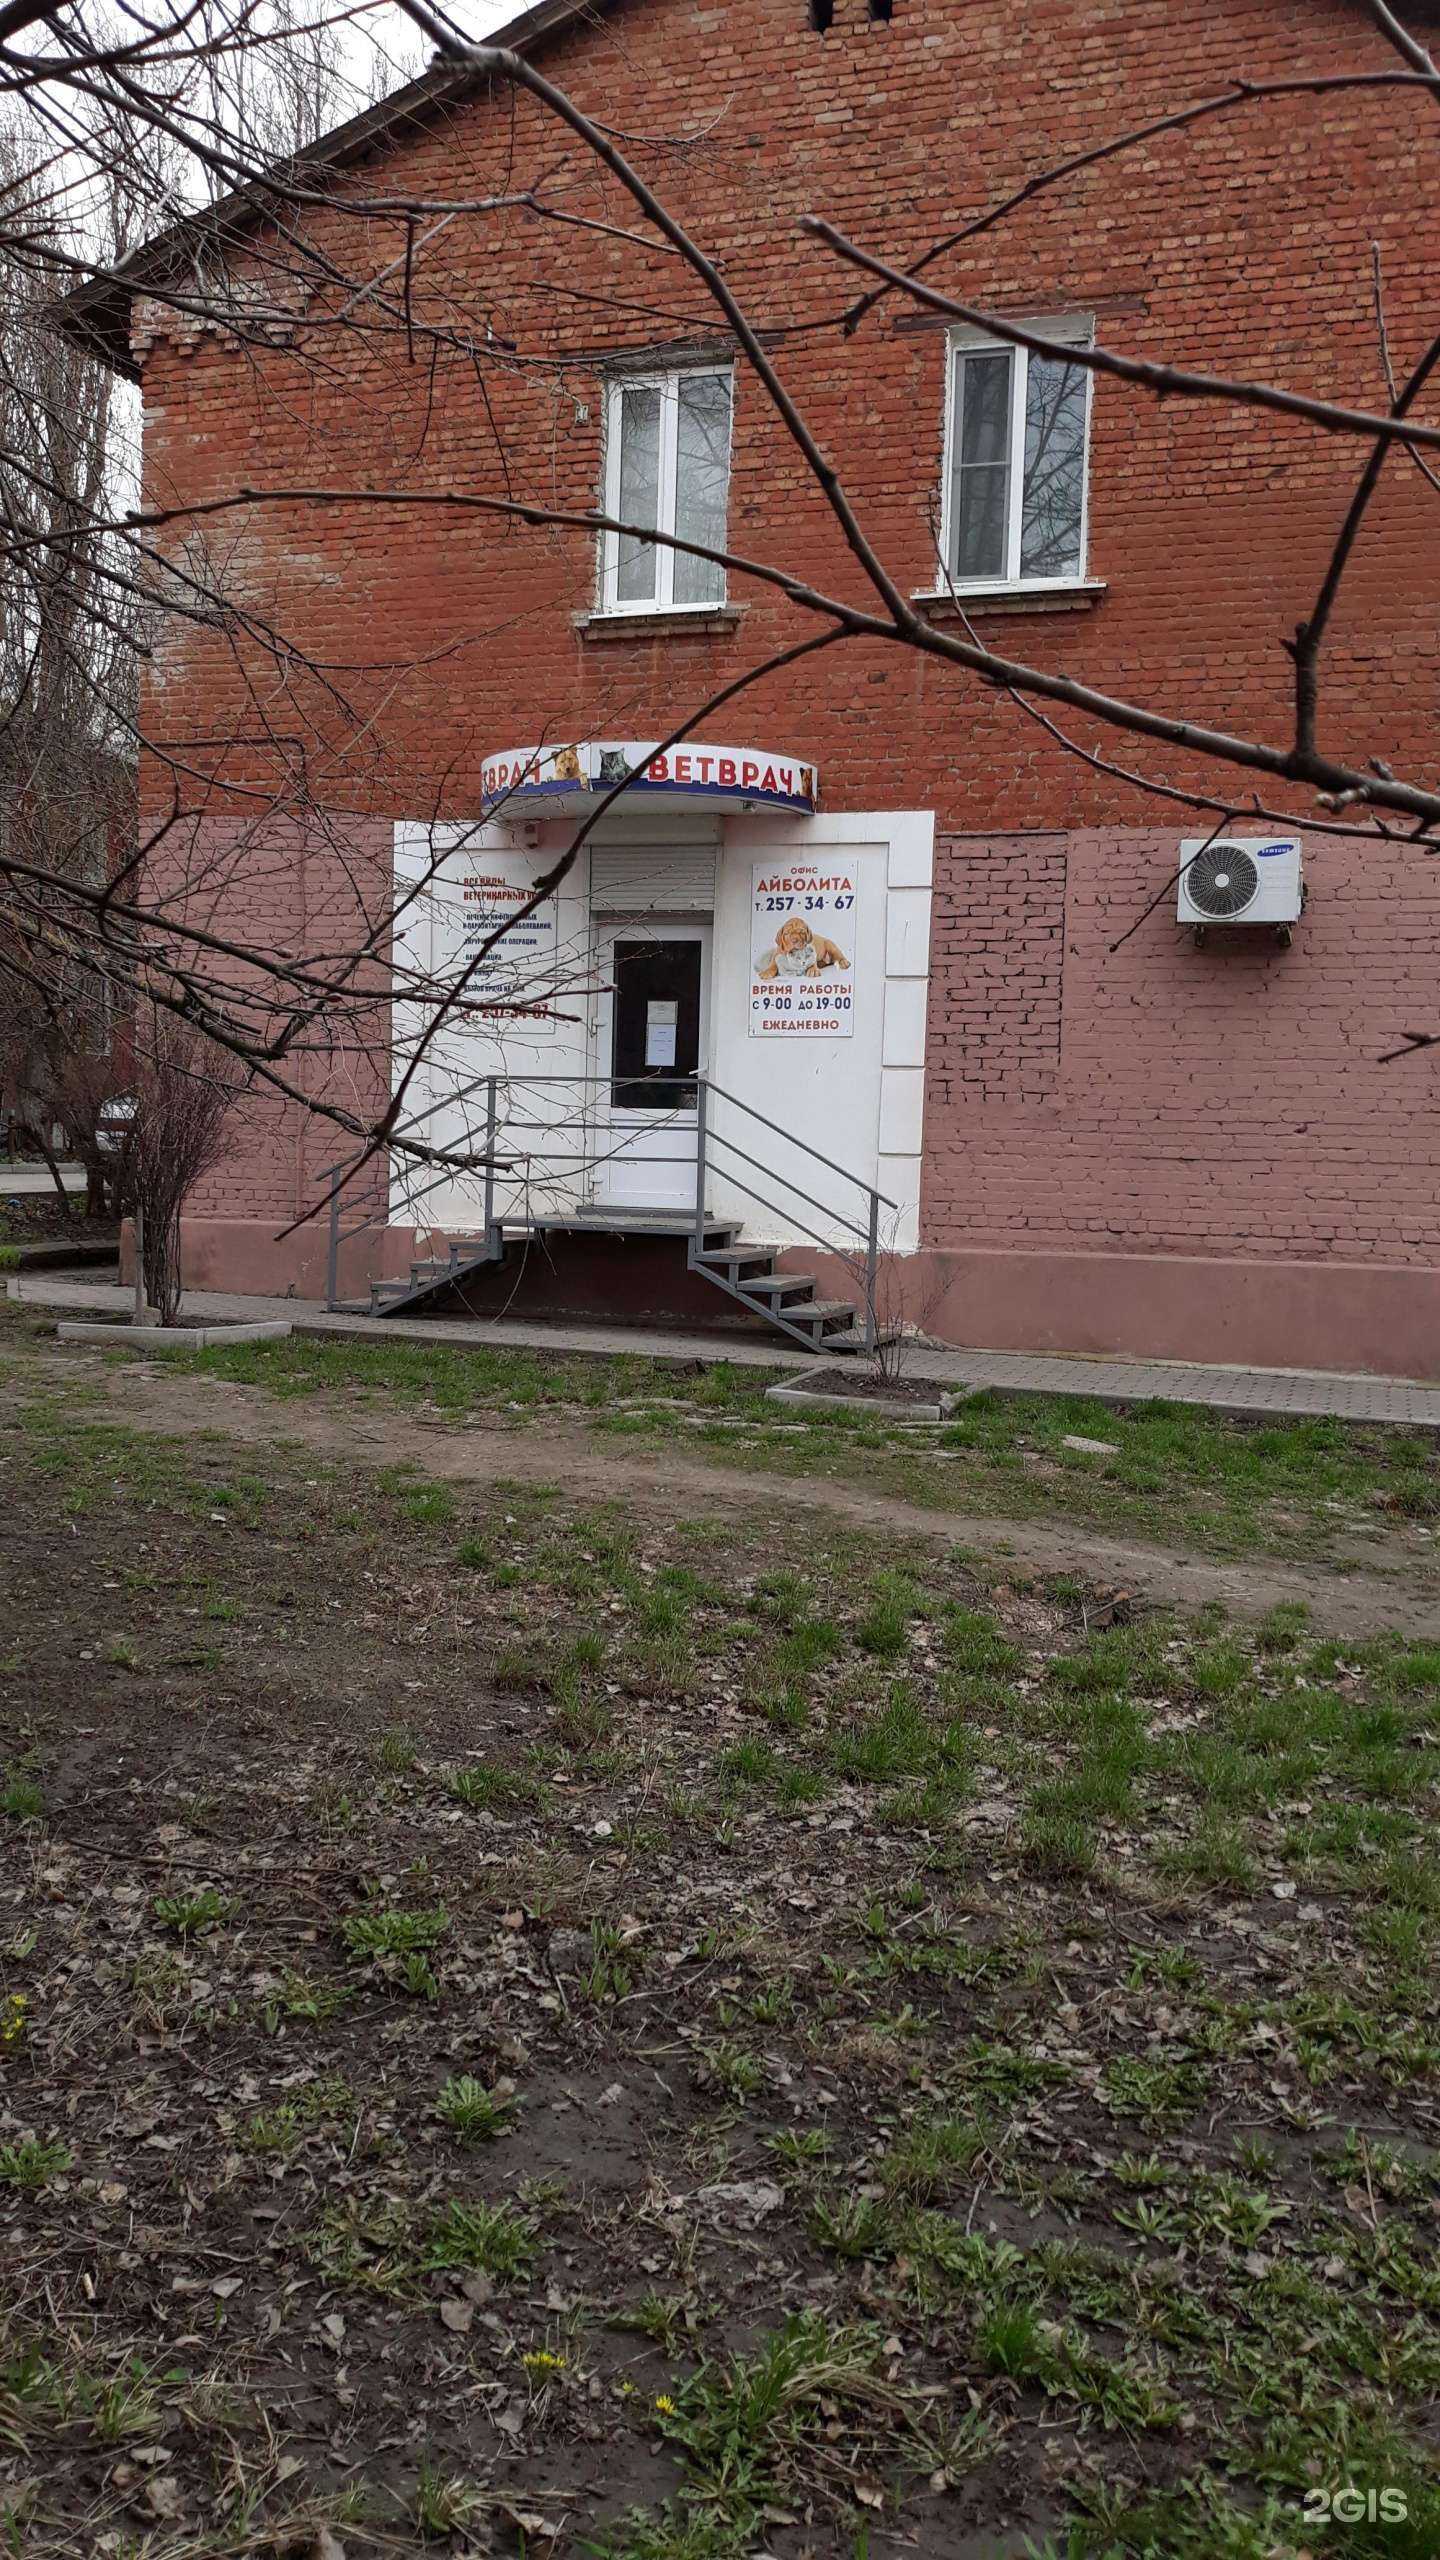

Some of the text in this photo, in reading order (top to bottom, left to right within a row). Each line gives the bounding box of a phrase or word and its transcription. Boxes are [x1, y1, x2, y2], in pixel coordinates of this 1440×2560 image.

[648, 754, 793, 795] ВЕТВРАЧ
[790, 866, 818, 875] ОФИС
[756, 875, 852, 892] АЙБОЛИТА
[752, 984, 852, 995] ВРЕМЯ РАБОТЫ
[762, 997, 792, 1010] 9-00
[816, 997, 851, 1010] 19-00
[762, 1020, 840, 1031] ЕЖЕДНЕВНО
